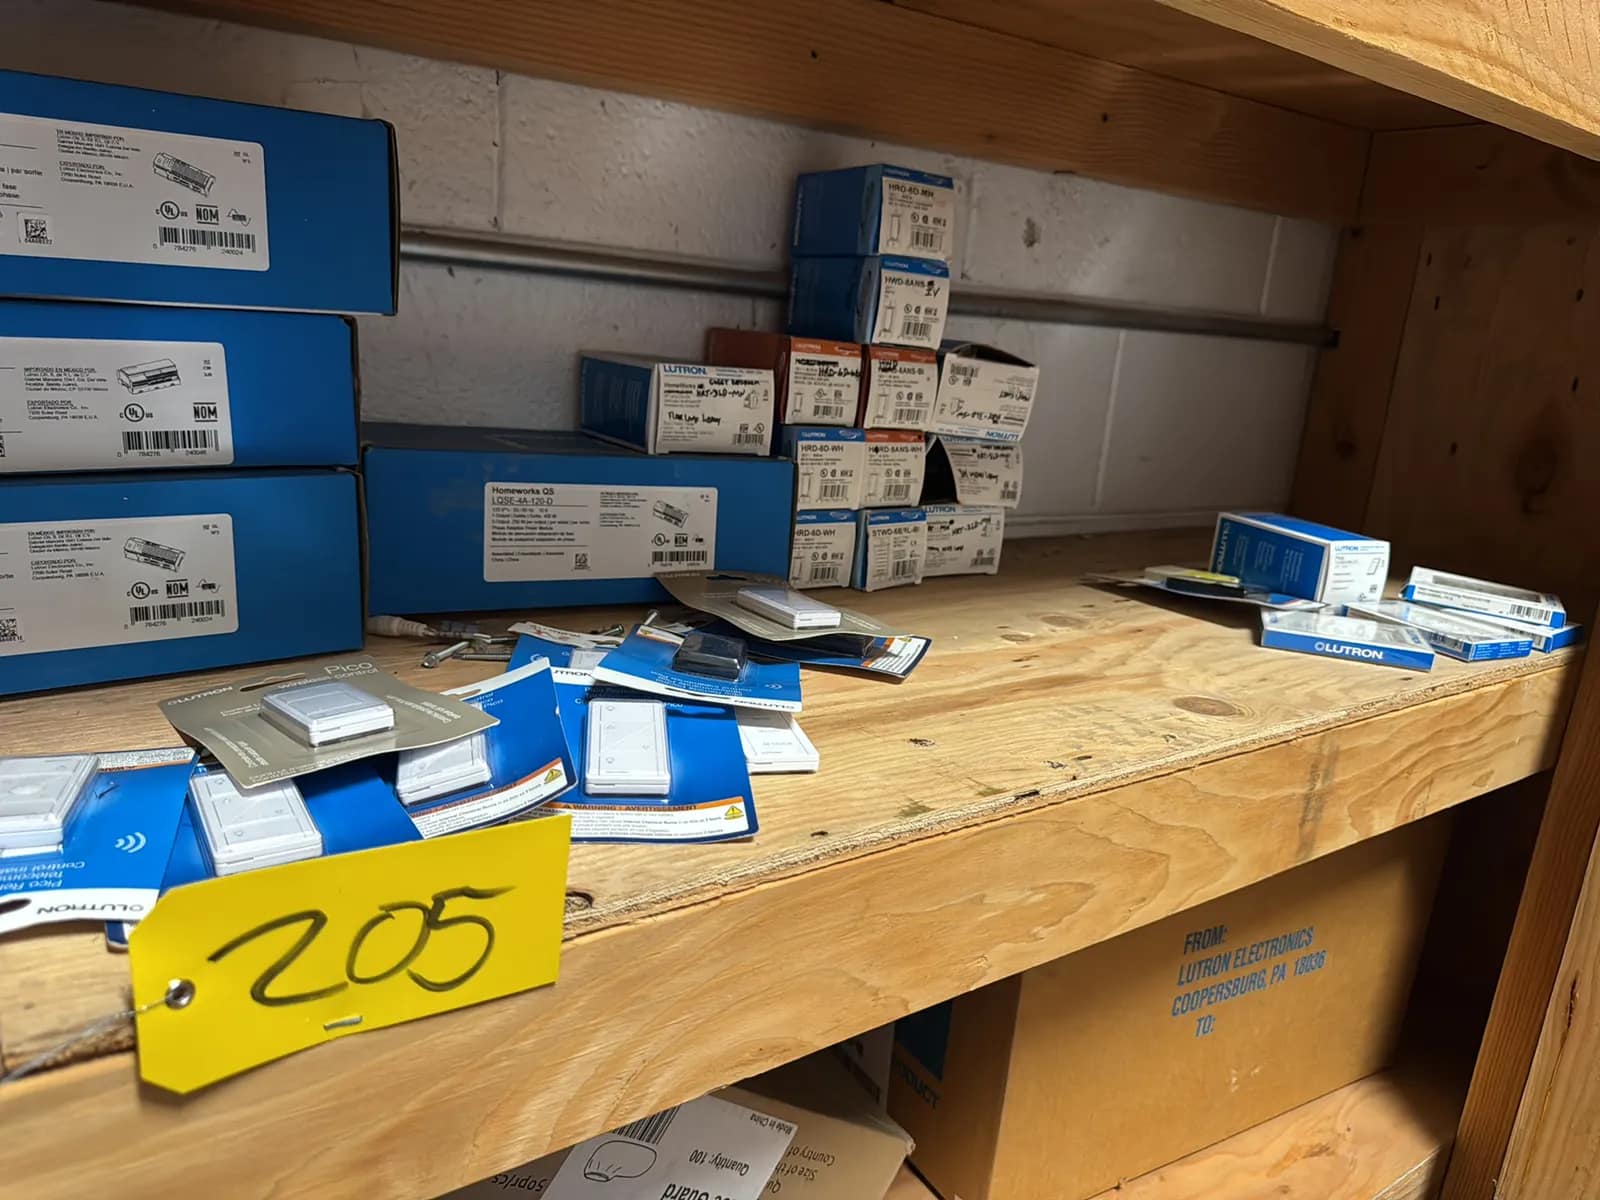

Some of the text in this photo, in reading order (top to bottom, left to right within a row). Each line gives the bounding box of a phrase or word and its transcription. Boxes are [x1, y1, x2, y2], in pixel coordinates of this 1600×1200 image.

[195, 207, 220, 222] NOM
[663, 365, 706, 375] LUTRON
[193, 406, 218, 419] NOM
[491, 487, 555, 496] Homeworks QS
[491, 496, 553, 505] LQSE-4A-120-D
[166, 582, 189, 595] NOM
[1323, 641, 1384, 661] LUTRON
[324, 662, 373, 676] Pico
[334, 667, 380, 680] control
[172, 685, 234, 704] LUTRON
[28, 879, 64, 889] Pico
[37, 903, 129, 915] LUTRON
[206, 885, 517, 1008] 205
[1183, 924, 1228, 955] FROM:
[1177, 926, 1314, 987] LUTRON ELECTRONICS
[1171, 949, 1327, 1017] COOPERSBURG, PA 18036
[1195, 1014, 1217, 1038] TO:
[749, 1113, 769, 1128] China
[775, 1123, 794, 1136] Made
[688, 1148, 750, 1177] Quantity: 100
[786, 1145, 836, 1167] Country of
[784, 1164, 798, 1177] of
[798, 1167, 818, 1181] Size
